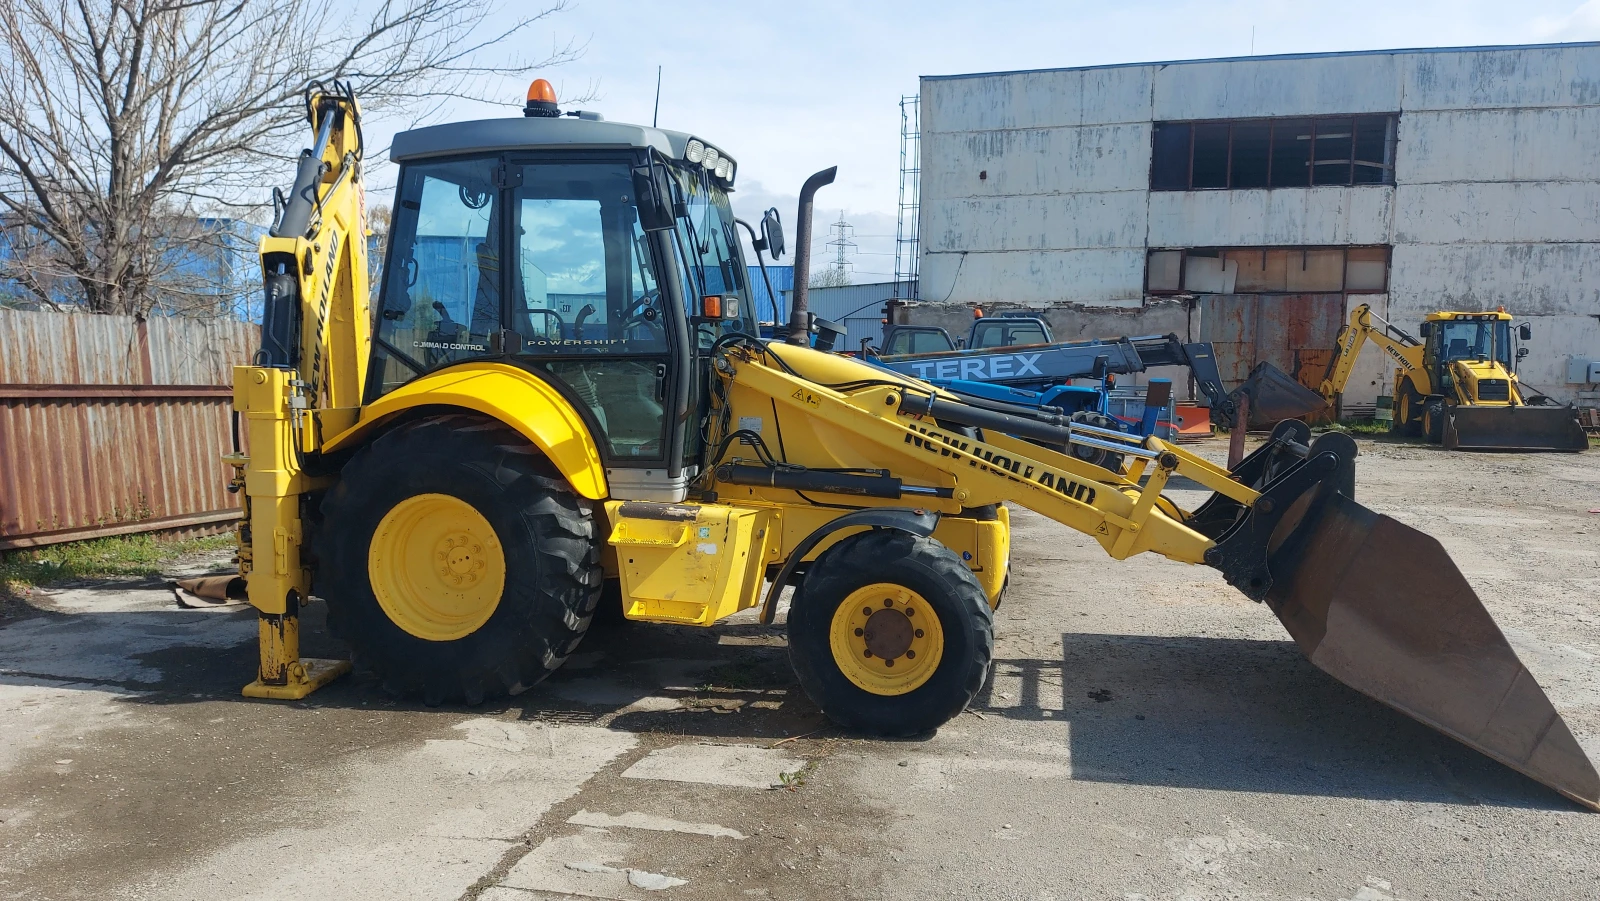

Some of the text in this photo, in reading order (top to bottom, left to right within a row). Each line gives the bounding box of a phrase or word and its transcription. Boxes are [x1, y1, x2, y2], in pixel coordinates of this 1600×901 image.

[310, 230, 338, 409] NEW HOLLAND
[450, 343, 485, 351] CONTROL
[1386, 345, 1400, 358] NEW
[912, 354, 1043, 380] TEREX
[904, 424, 1096, 506] NEW HOLLAND
